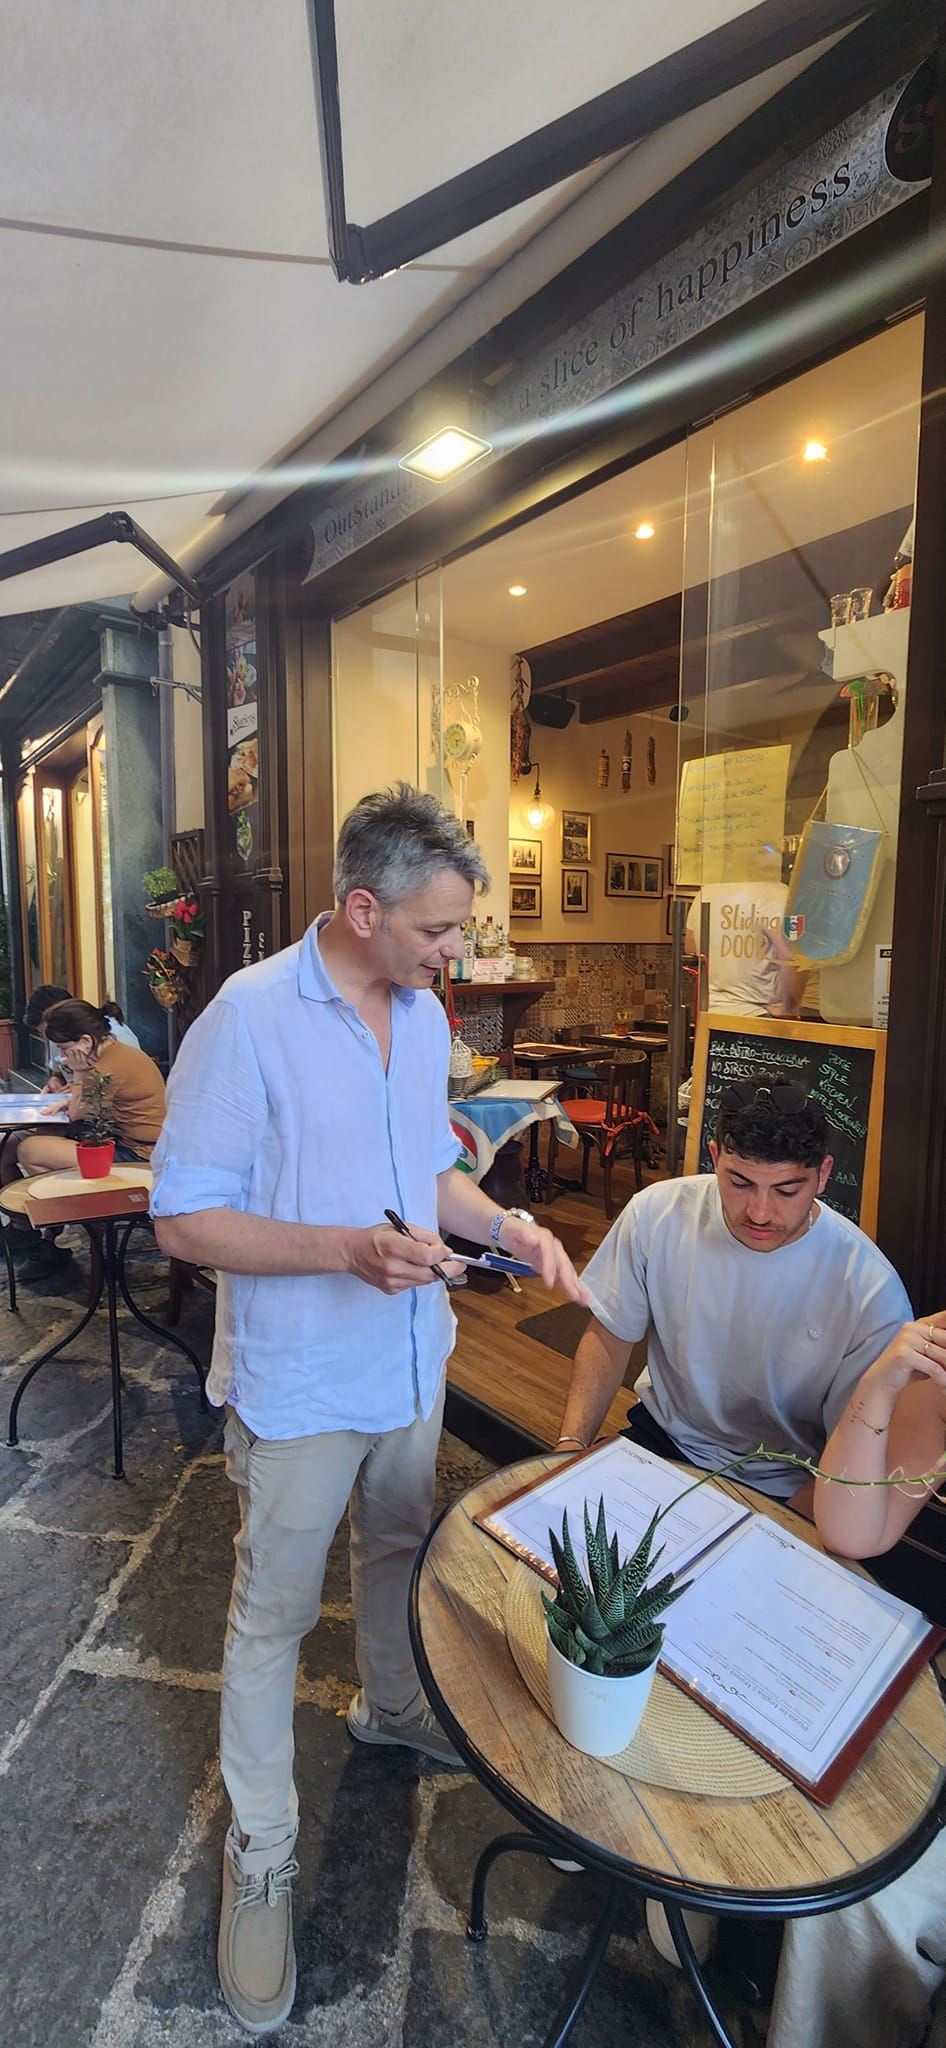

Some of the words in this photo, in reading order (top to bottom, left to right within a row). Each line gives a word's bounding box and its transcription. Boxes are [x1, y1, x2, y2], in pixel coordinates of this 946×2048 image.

[519, 388, 530, 412] a
[540, 340, 599, 398] slice
[609, 296, 643, 350] of
[655, 162, 852, 320] happiness
[723, 1061, 756, 1078] STRESS
[818, 1063, 850, 1087] STYLE
